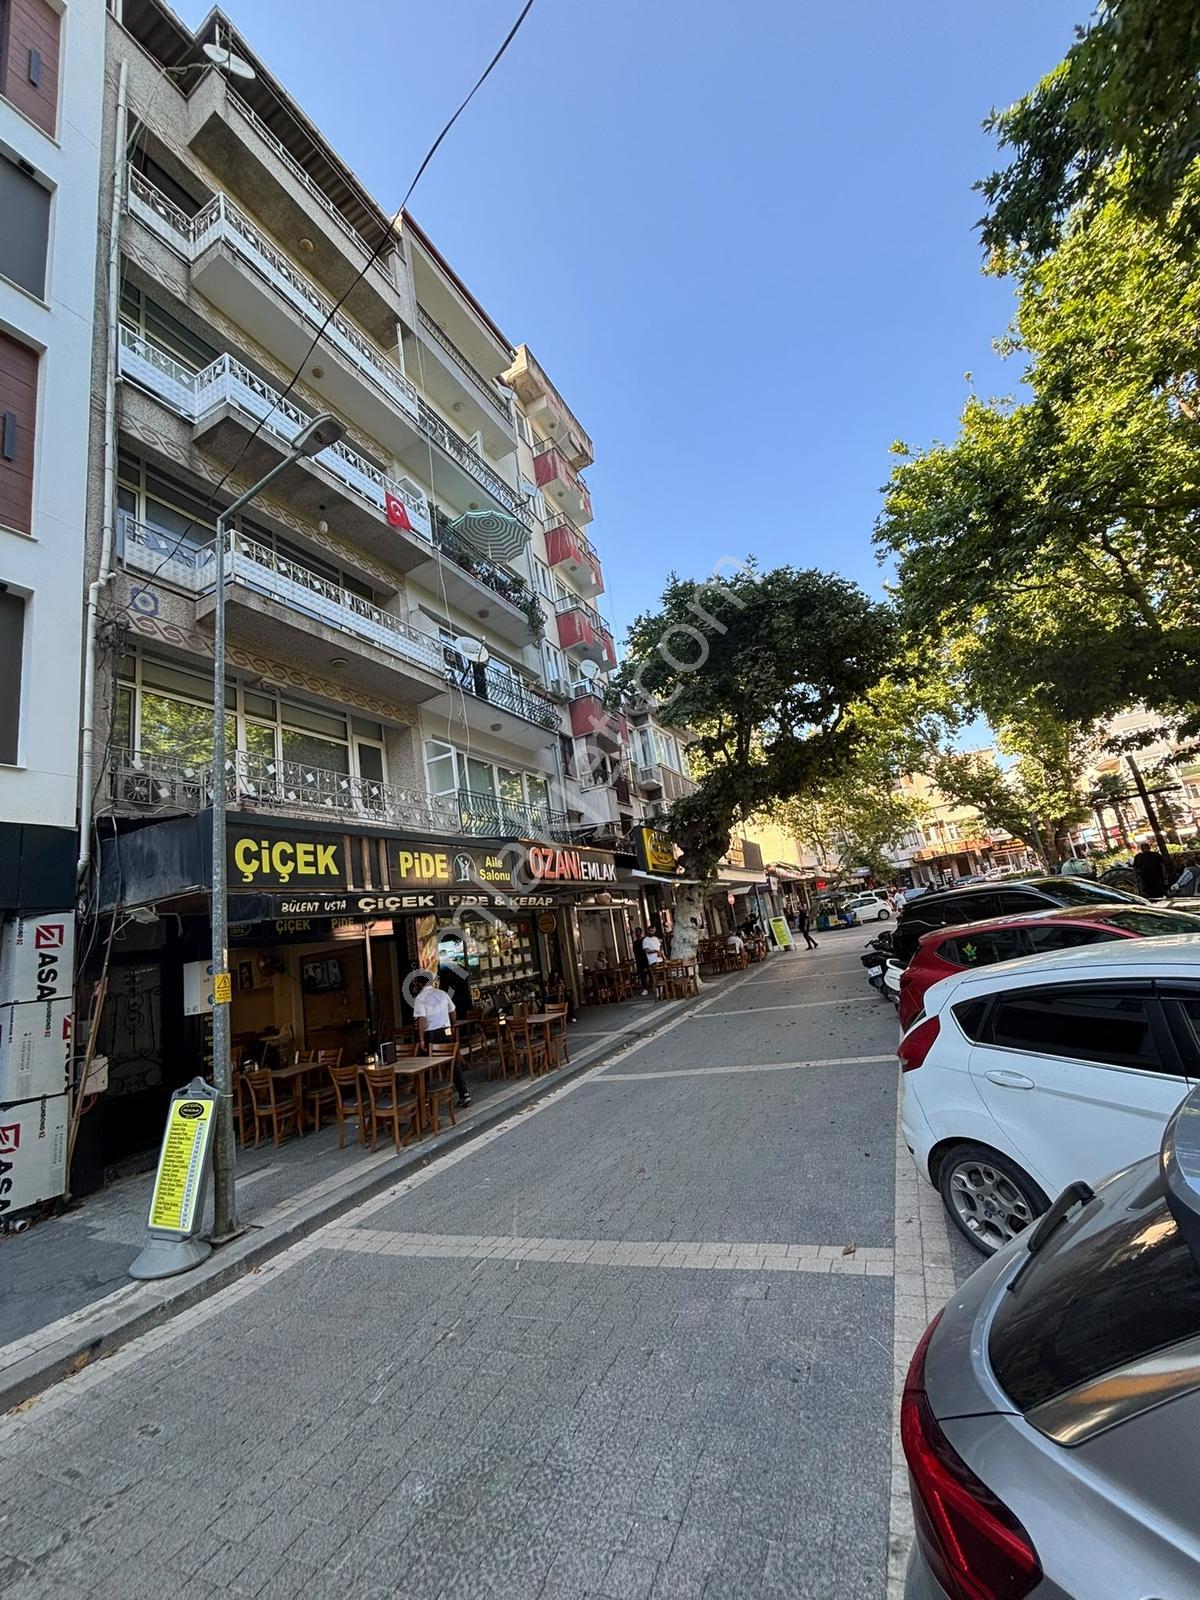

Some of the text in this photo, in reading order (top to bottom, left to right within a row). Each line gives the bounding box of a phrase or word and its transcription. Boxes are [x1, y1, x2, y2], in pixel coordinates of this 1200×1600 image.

[485, 855, 504, 869] Aile
[529, 846, 617, 883] OZAN EMLAK
[479, 868, 511, 882] Salonu
[281, 900, 320, 913] BÜLENT
[494, 895, 506, 906] &
[509, 896, 554, 907] KEBAP
